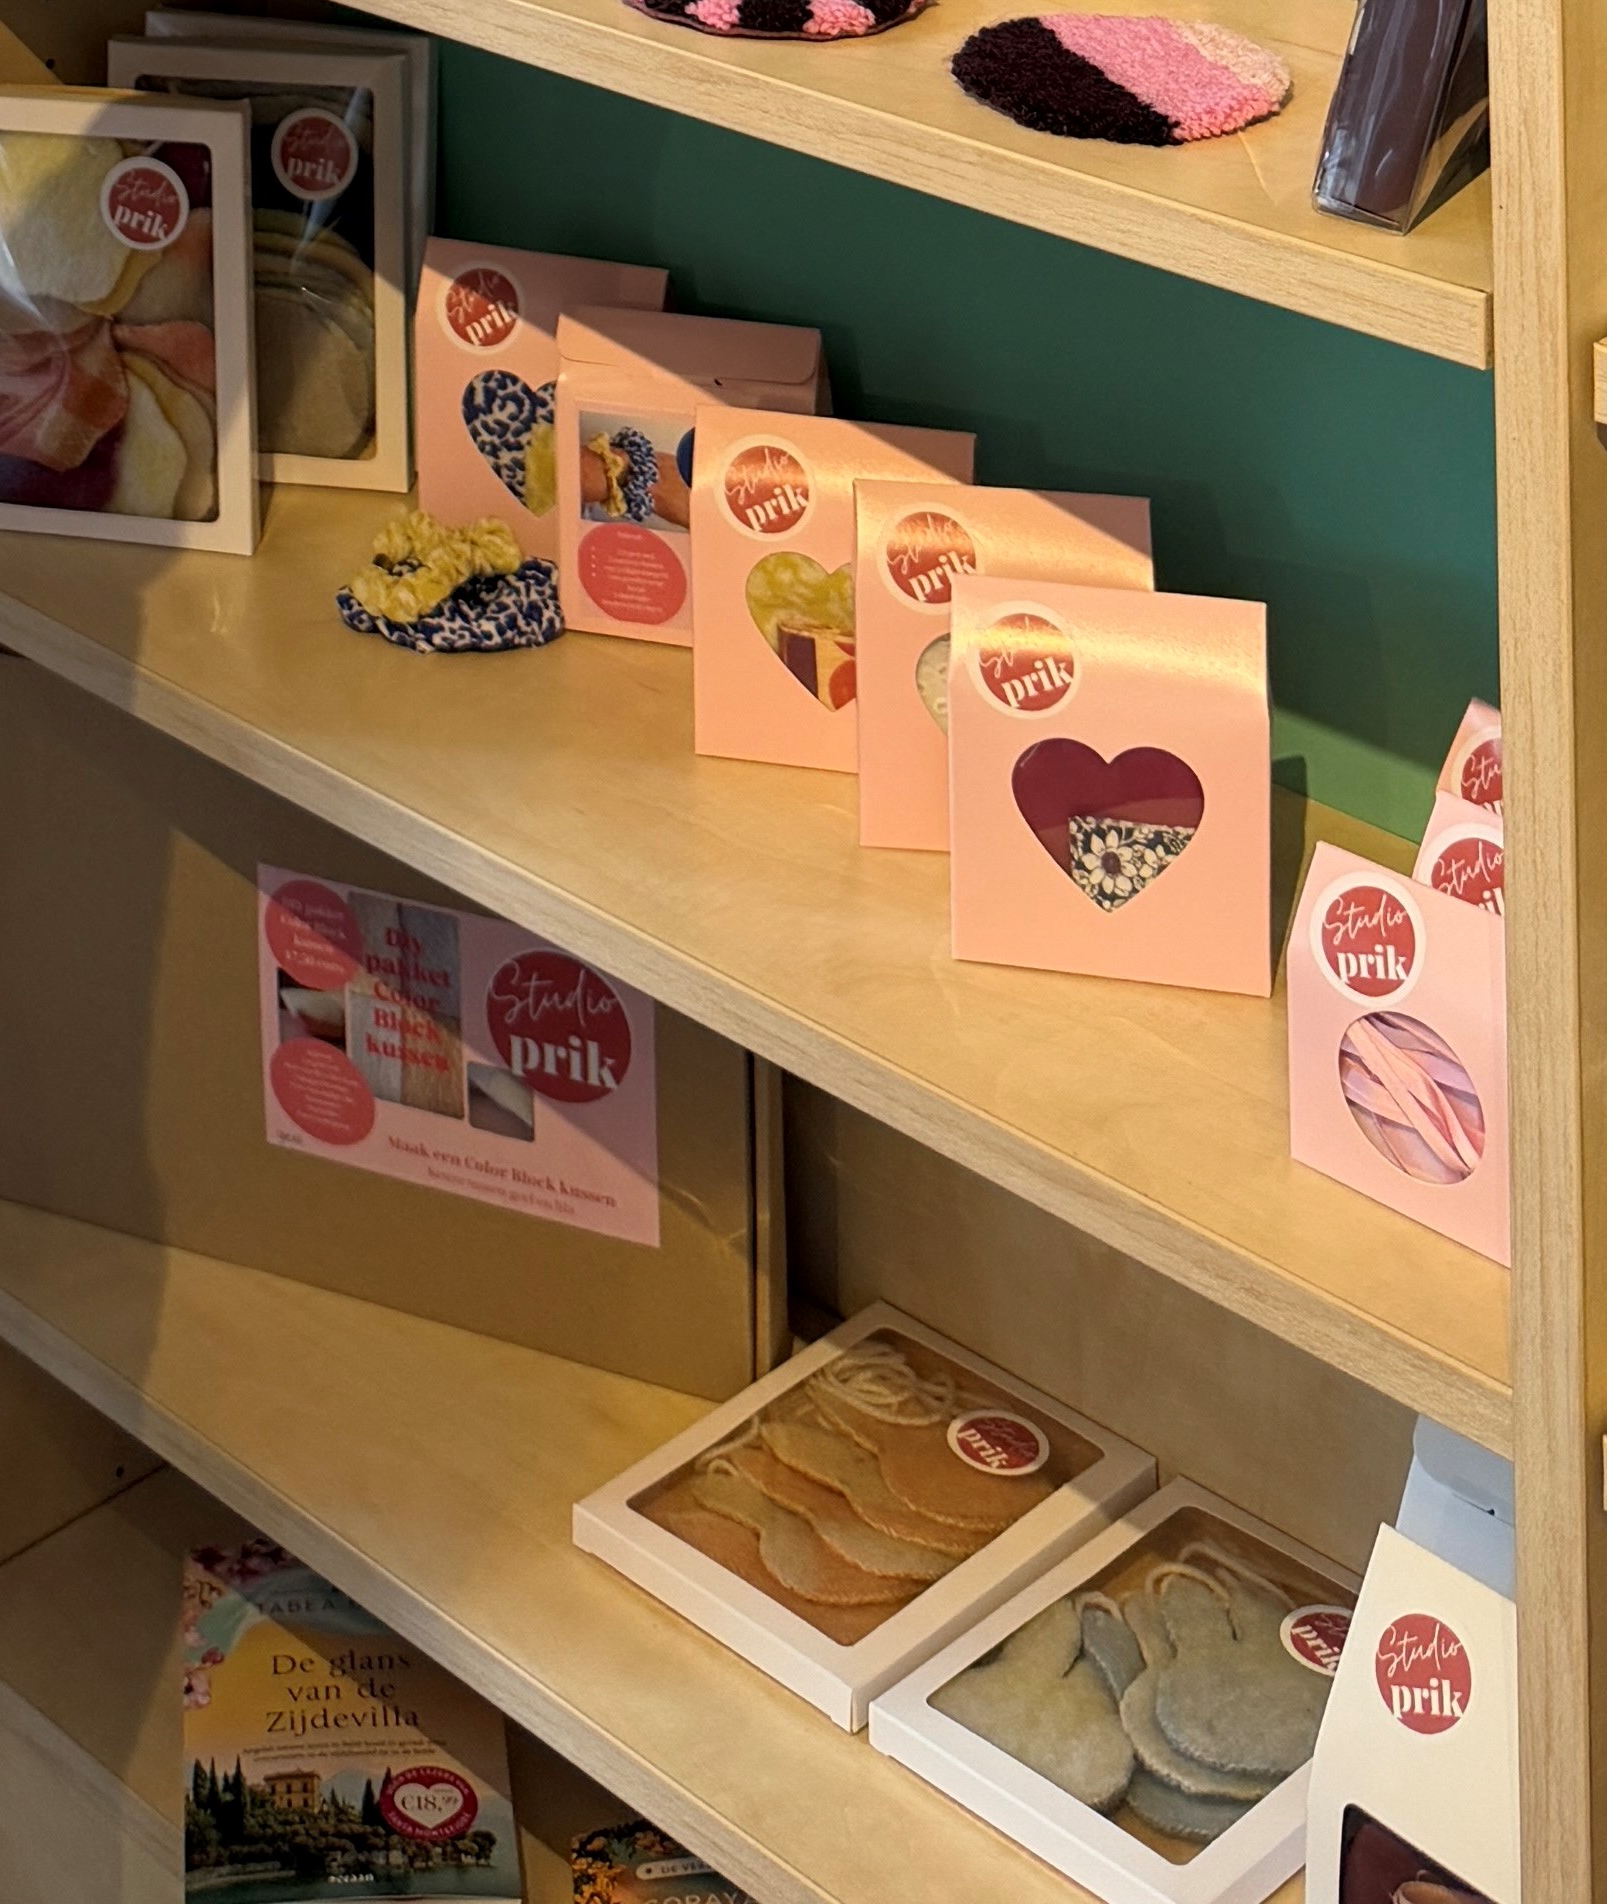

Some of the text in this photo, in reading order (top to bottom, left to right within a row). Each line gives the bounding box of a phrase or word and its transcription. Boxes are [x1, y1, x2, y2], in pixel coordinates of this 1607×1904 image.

[287, 157, 343, 185] prik
[113, 204, 169, 242] prik
[465, 301, 518, 347] prik
[745, 484, 809, 532] prik
[909, 551, 975, 603] prik
[1001, 656, 1073, 708] prik
[1461, 754, 1502, 799] Stu
[1323, 894, 1407, 945] Studio
[1337, 944, 1408, 984] prik
[491, 959, 619, 1028] Studio
[509, 1035, 618, 1091] prik
[957, 1428, 1008, 1469] prik
[272, 1649, 411, 1678] De glans
[1378, 1623, 1463, 1678] Studio
[287, 1678, 395, 1703] van de
[1390, 1677, 1464, 1720] prik
[266, 1706, 420, 1737] Zijdevilla
